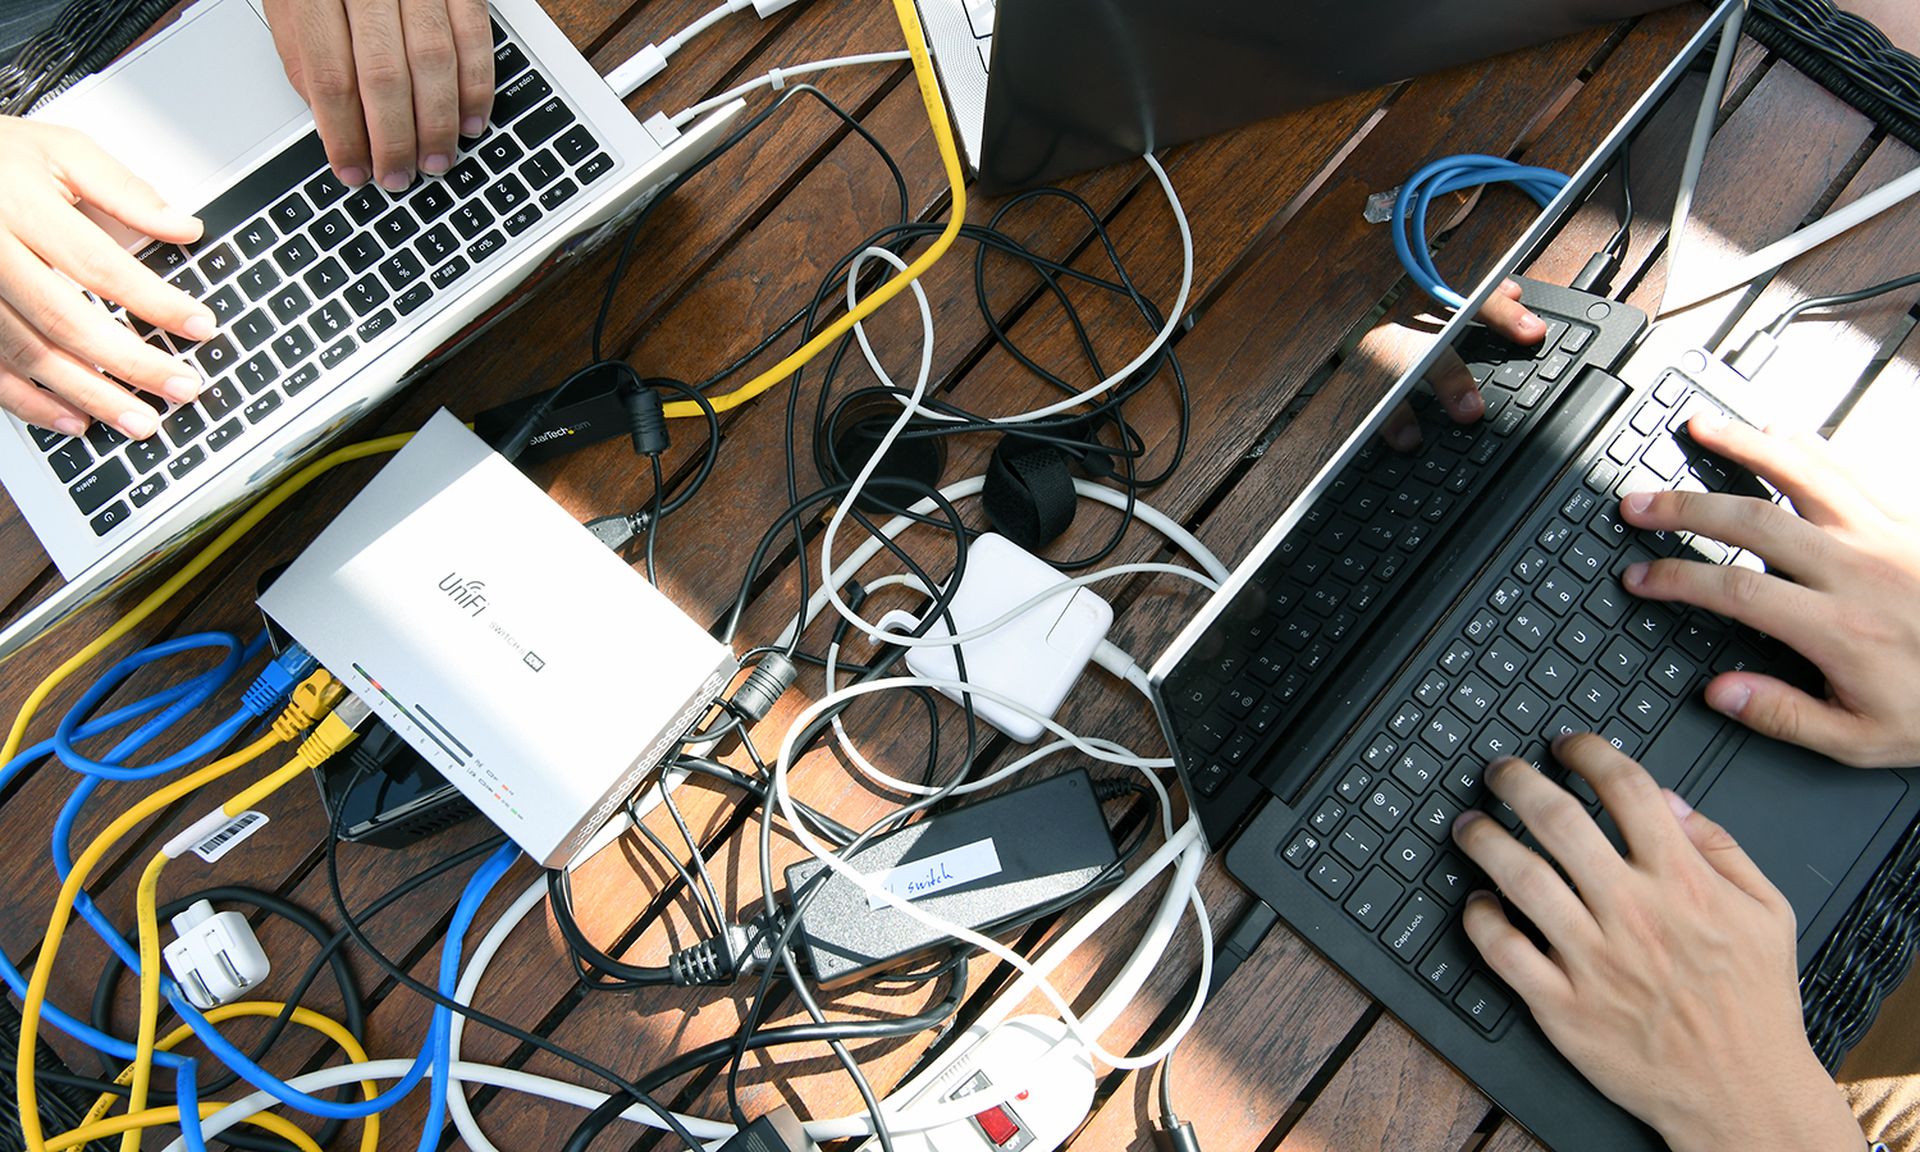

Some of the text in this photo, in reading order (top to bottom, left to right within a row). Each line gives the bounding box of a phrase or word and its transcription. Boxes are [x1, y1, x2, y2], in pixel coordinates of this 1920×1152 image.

[497, 48, 512, 61] shift
[505, 74, 535, 97] caps lock
[545, 102, 558, 113] tab
[494, 147, 506, 157] Q
[588, 162, 600, 173] esc
[460, 171, 473, 184] W
[322, 184, 332, 194] V
[362, 199, 370, 209] F
[426, 197, 436, 207] E
[285, 207, 296, 218] B
[324, 224, 335, 235] G
[390, 221, 401, 231] R
[248, 231, 261, 244] N
[288, 247, 300, 260] H
[357, 247, 366, 258] T
[211, 256, 226, 269] M
[254, 274, 262, 285] J
[321, 272, 331, 283] Y
[216, 299, 229, 311] K
[283, 297, 296, 309] U
[211, 349, 223, 360] O
[75, 475, 98, 493] delete
[1565, 494, 1582, 513] PrtScr
[1614, 524, 1624, 534] 0
[1587, 557, 1597, 568] 9
[438, 571, 490, 618] UniFi
[1559, 592, 1570, 602] 8
[1531, 626, 1541, 636] 7
[1642, 619, 1656, 632] K
[1573, 630, 1586, 644] U
[1619, 653, 1628, 665] J
[1503, 661, 1514, 671] 6
[1545, 666, 1557, 678] Y
[1664, 664, 1680, 679] M
[1587, 688, 1601, 703] H
[1475, 697, 1485, 708] 5
[1517, 702, 1529, 713] T
[1637, 700, 1652, 714] N
[1448, 733, 1458, 743] 4
[1610, 737, 1623, 750] B
[1489, 739, 1502, 752] R
[1417, 769, 1428, 780] 3
[1460, 774, 1474, 788] E
[1388, 806, 1399, 817] 2
[1430, 808, 1445, 825] W
[1286, 844, 1300, 857] Esc
[1360, 843, 1369, 852] 1
[1402, 848, 1416, 861] Q
[908, 862, 954, 894] switch
[1446, 874, 1458, 886] A
[1357, 902, 1372, 917] Tab
[1394, 914, 1424, 949] Caps Lock
[1431, 962, 1448, 982] Shift
[1472, 999, 1487, 1015] Ctrl
